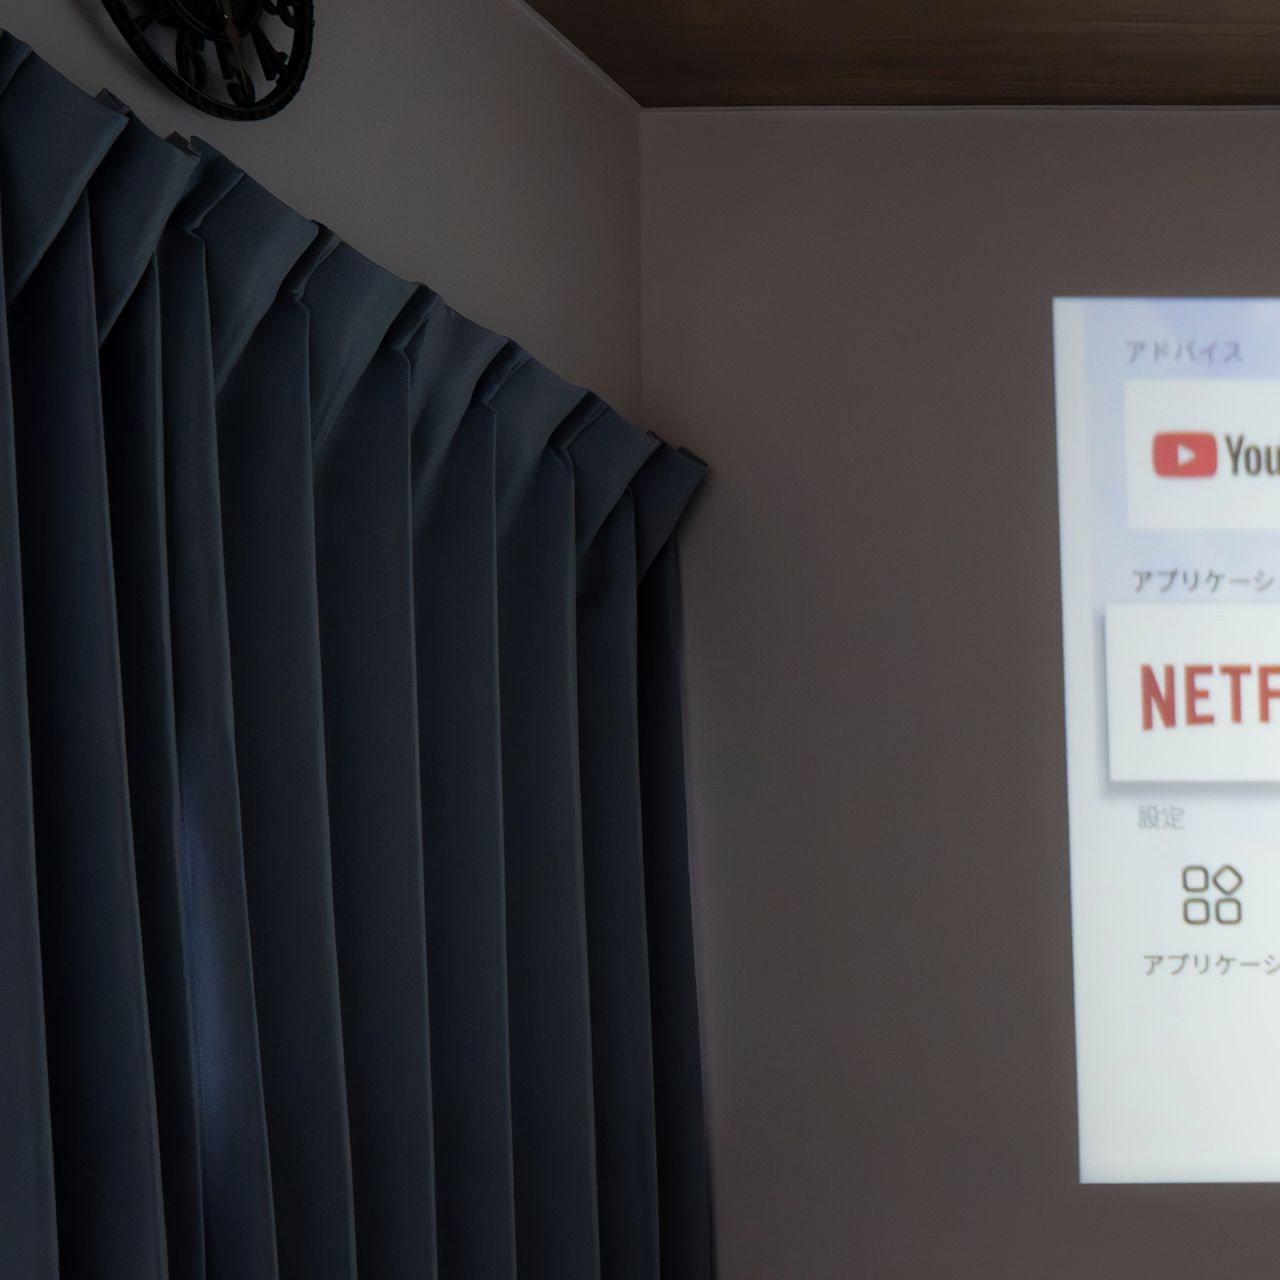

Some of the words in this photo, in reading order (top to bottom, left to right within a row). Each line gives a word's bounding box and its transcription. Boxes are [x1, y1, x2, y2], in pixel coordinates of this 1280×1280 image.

[1125, 341, 1245, 364] アドバイス
[1138, 805, 1186, 830] 設定
